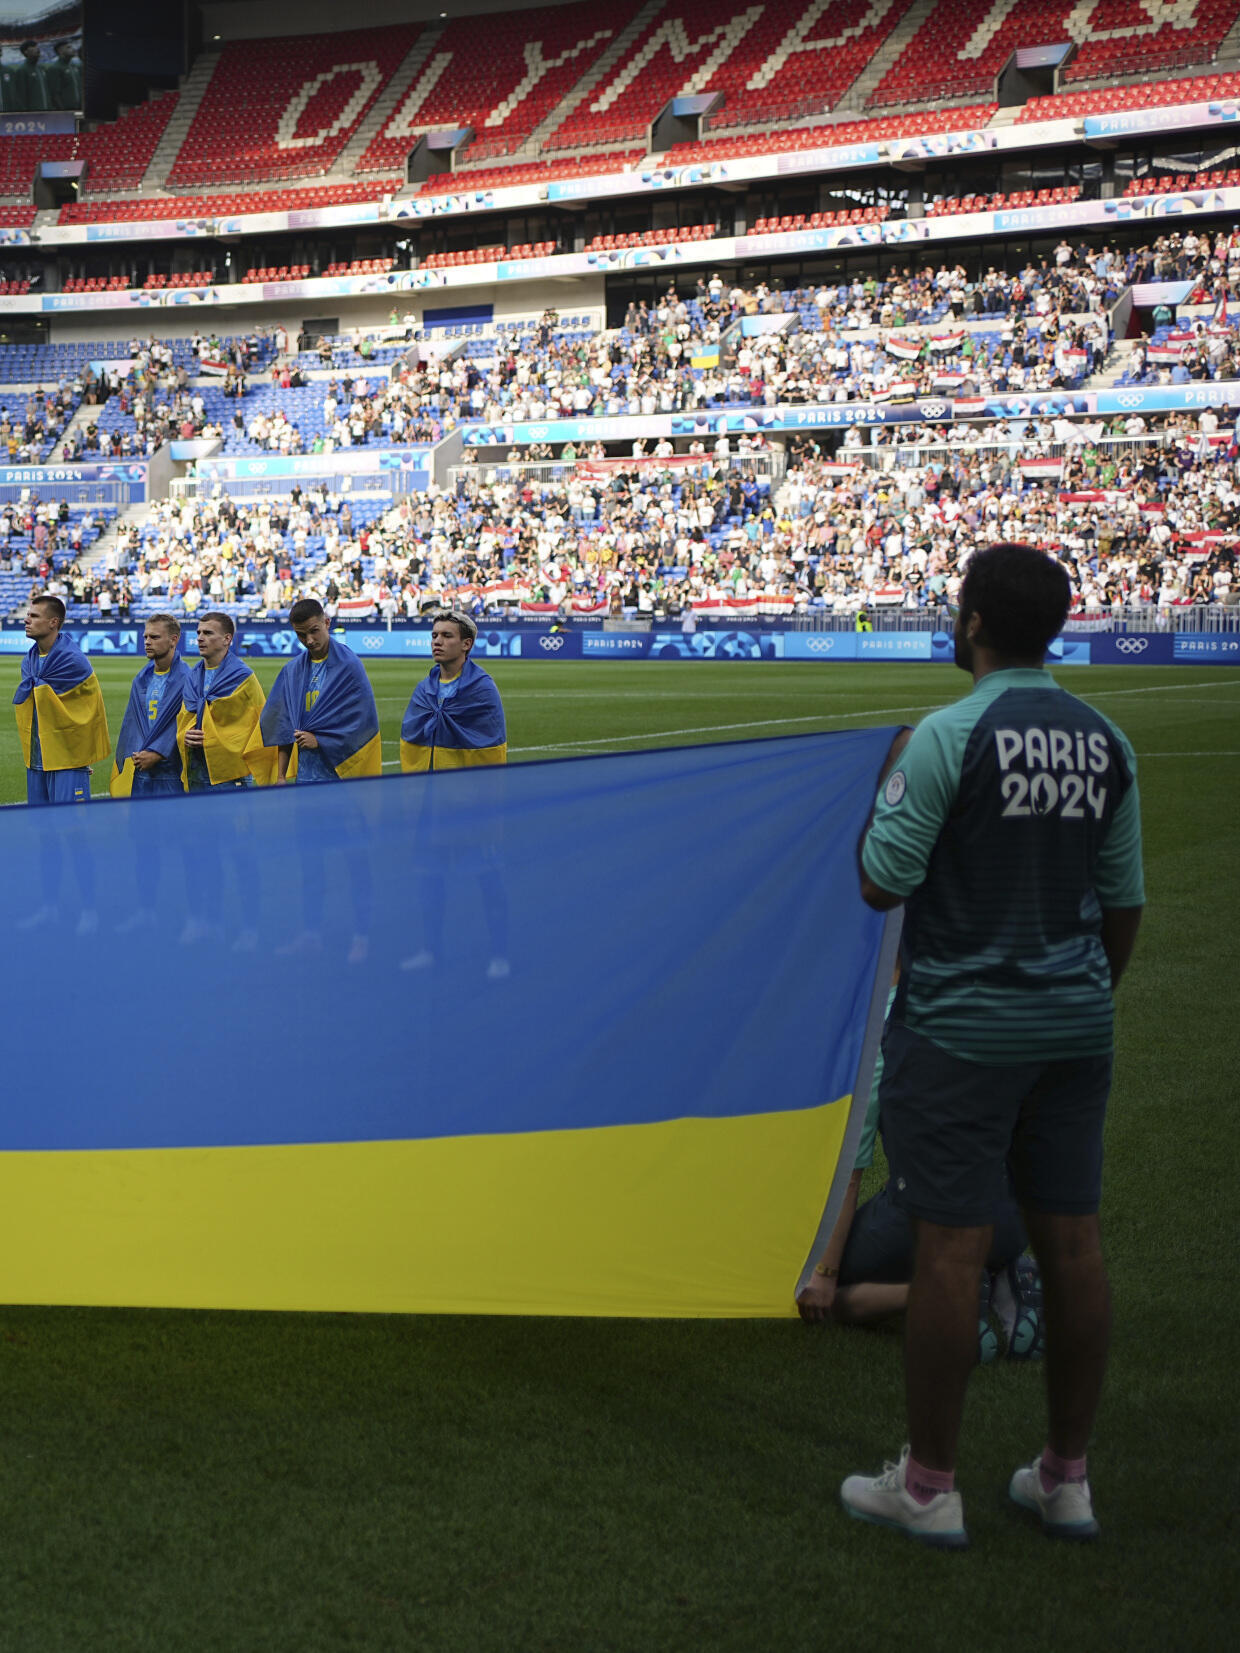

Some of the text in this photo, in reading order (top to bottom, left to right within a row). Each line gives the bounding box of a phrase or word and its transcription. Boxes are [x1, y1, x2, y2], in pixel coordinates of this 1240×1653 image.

[5, 121, 46, 133] 2024
[1185, 389, 1235, 403] PARIS
[797, 408, 886, 424] PARIS 2024
[6, 470, 82, 482] PARIS 2024
[587, 639, 642, 649] PARIS 2024
[862, 640, 893, 649] PARIS
[1181, 641, 1217, 651] PARIS
[148, 700, 159, 720] 5
[1001, 773, 1107, 819] 2024
